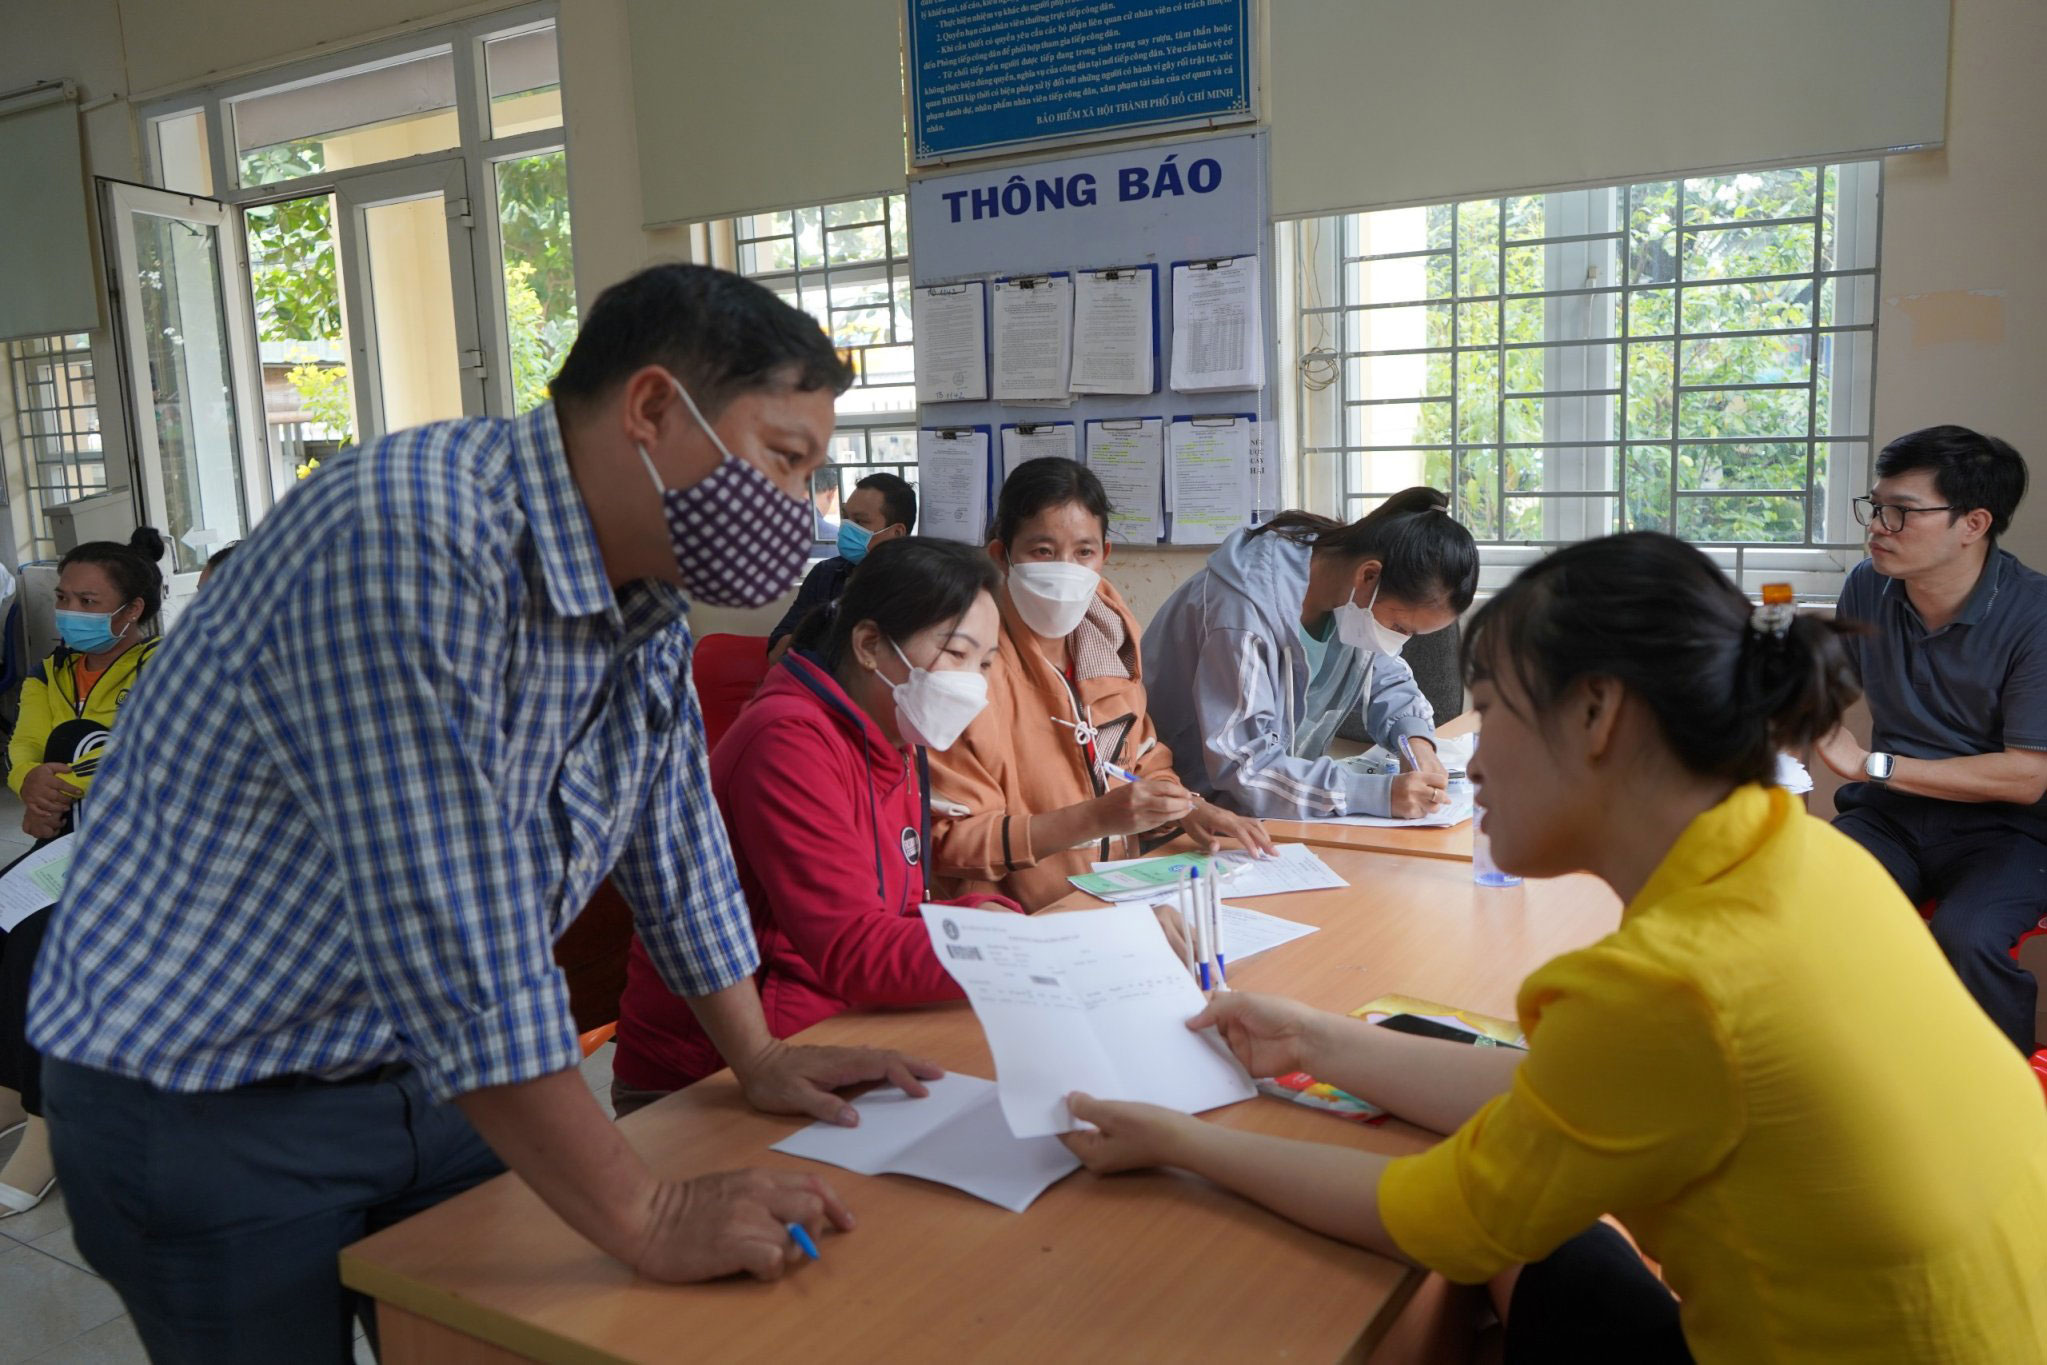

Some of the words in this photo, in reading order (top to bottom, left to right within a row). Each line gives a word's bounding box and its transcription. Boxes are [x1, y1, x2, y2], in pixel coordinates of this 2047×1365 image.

[1037, 111, 1055, 124] BẢO
[1056, 107, 1080, 121] HIỂM
[1082, 106, 1094, 117] XÃ
[1097, 104, 1114, 117] HỘI
[1116, 98, 1148, 113] THÀNH
[1150, 94, 1169, 107] PHỐ
[1172, 91, 1185, 104] HỒ
[1188, 90, 1205, 102] CHÍ
[1207, 88, 1233, 99] MINH
[942, 173, 1097, 224] THÔNG
[1118, 153, 1223, 203] BÁO
